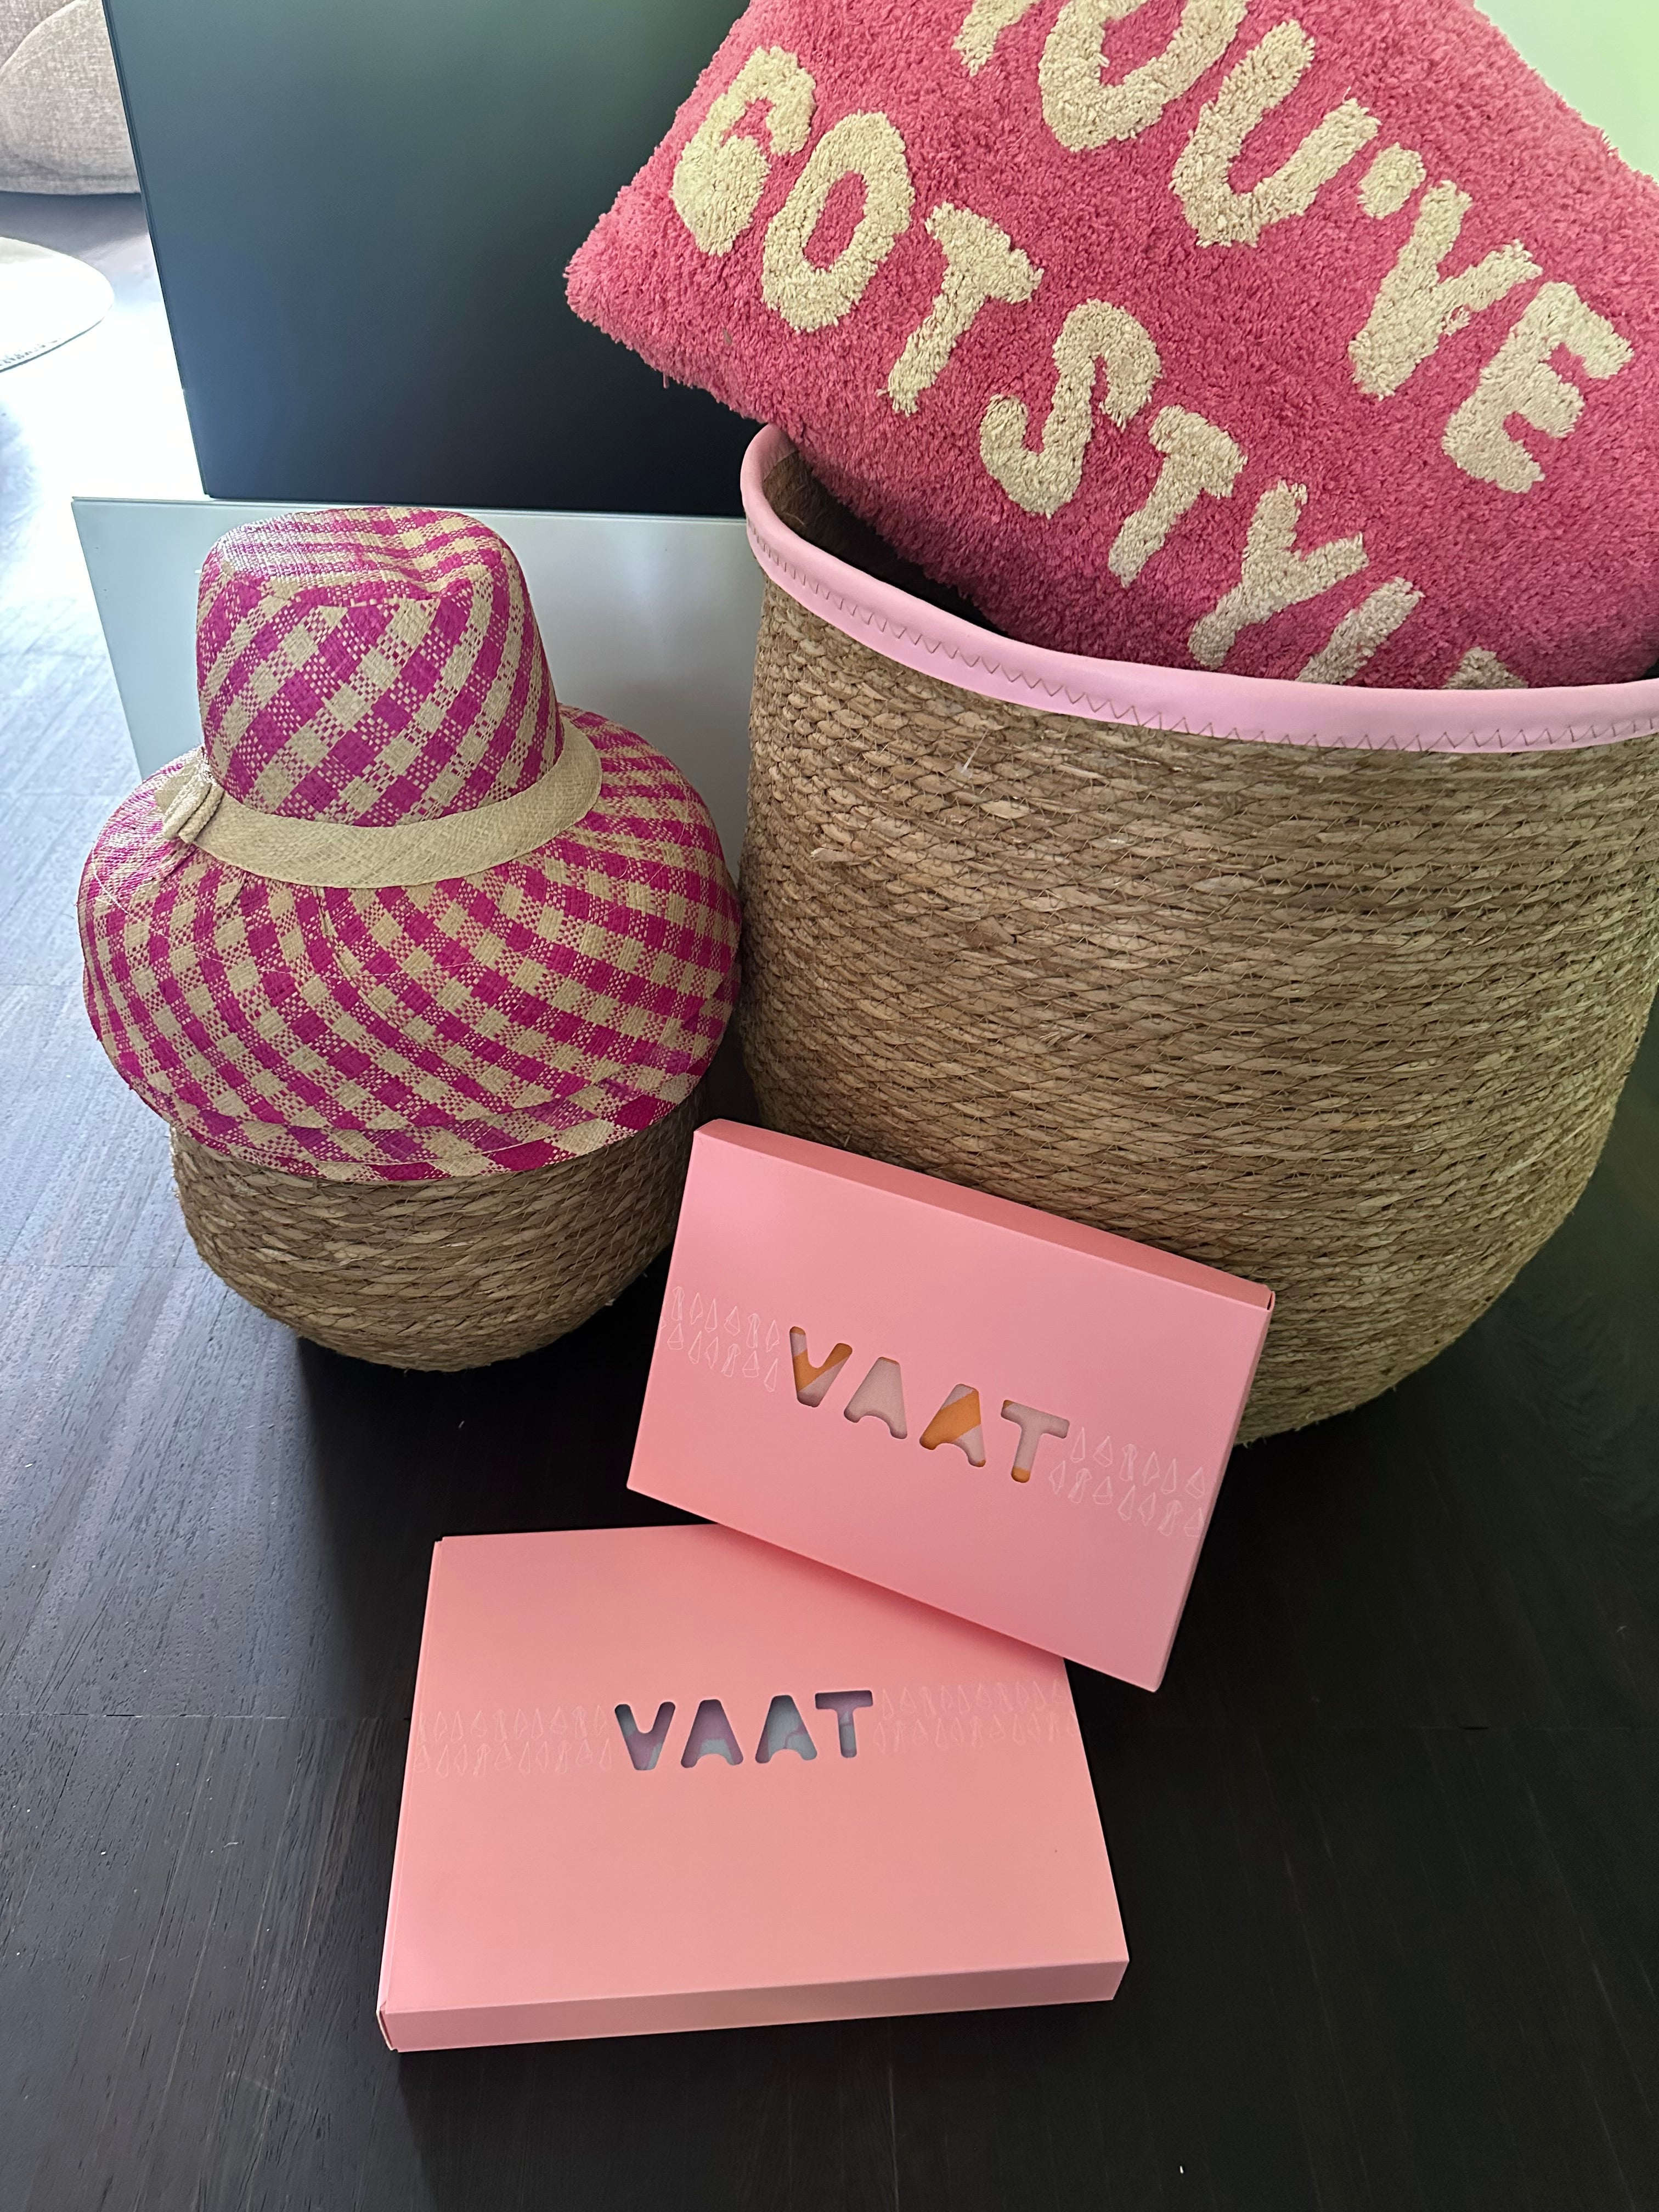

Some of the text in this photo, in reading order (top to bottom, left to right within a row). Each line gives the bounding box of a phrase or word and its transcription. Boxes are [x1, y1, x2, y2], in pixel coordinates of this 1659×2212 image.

[670, 45, 1044, 416] GOT
[789, 1326, 1070, 1483] VAAT
[614, 1690, 873, 1771] VAAT
